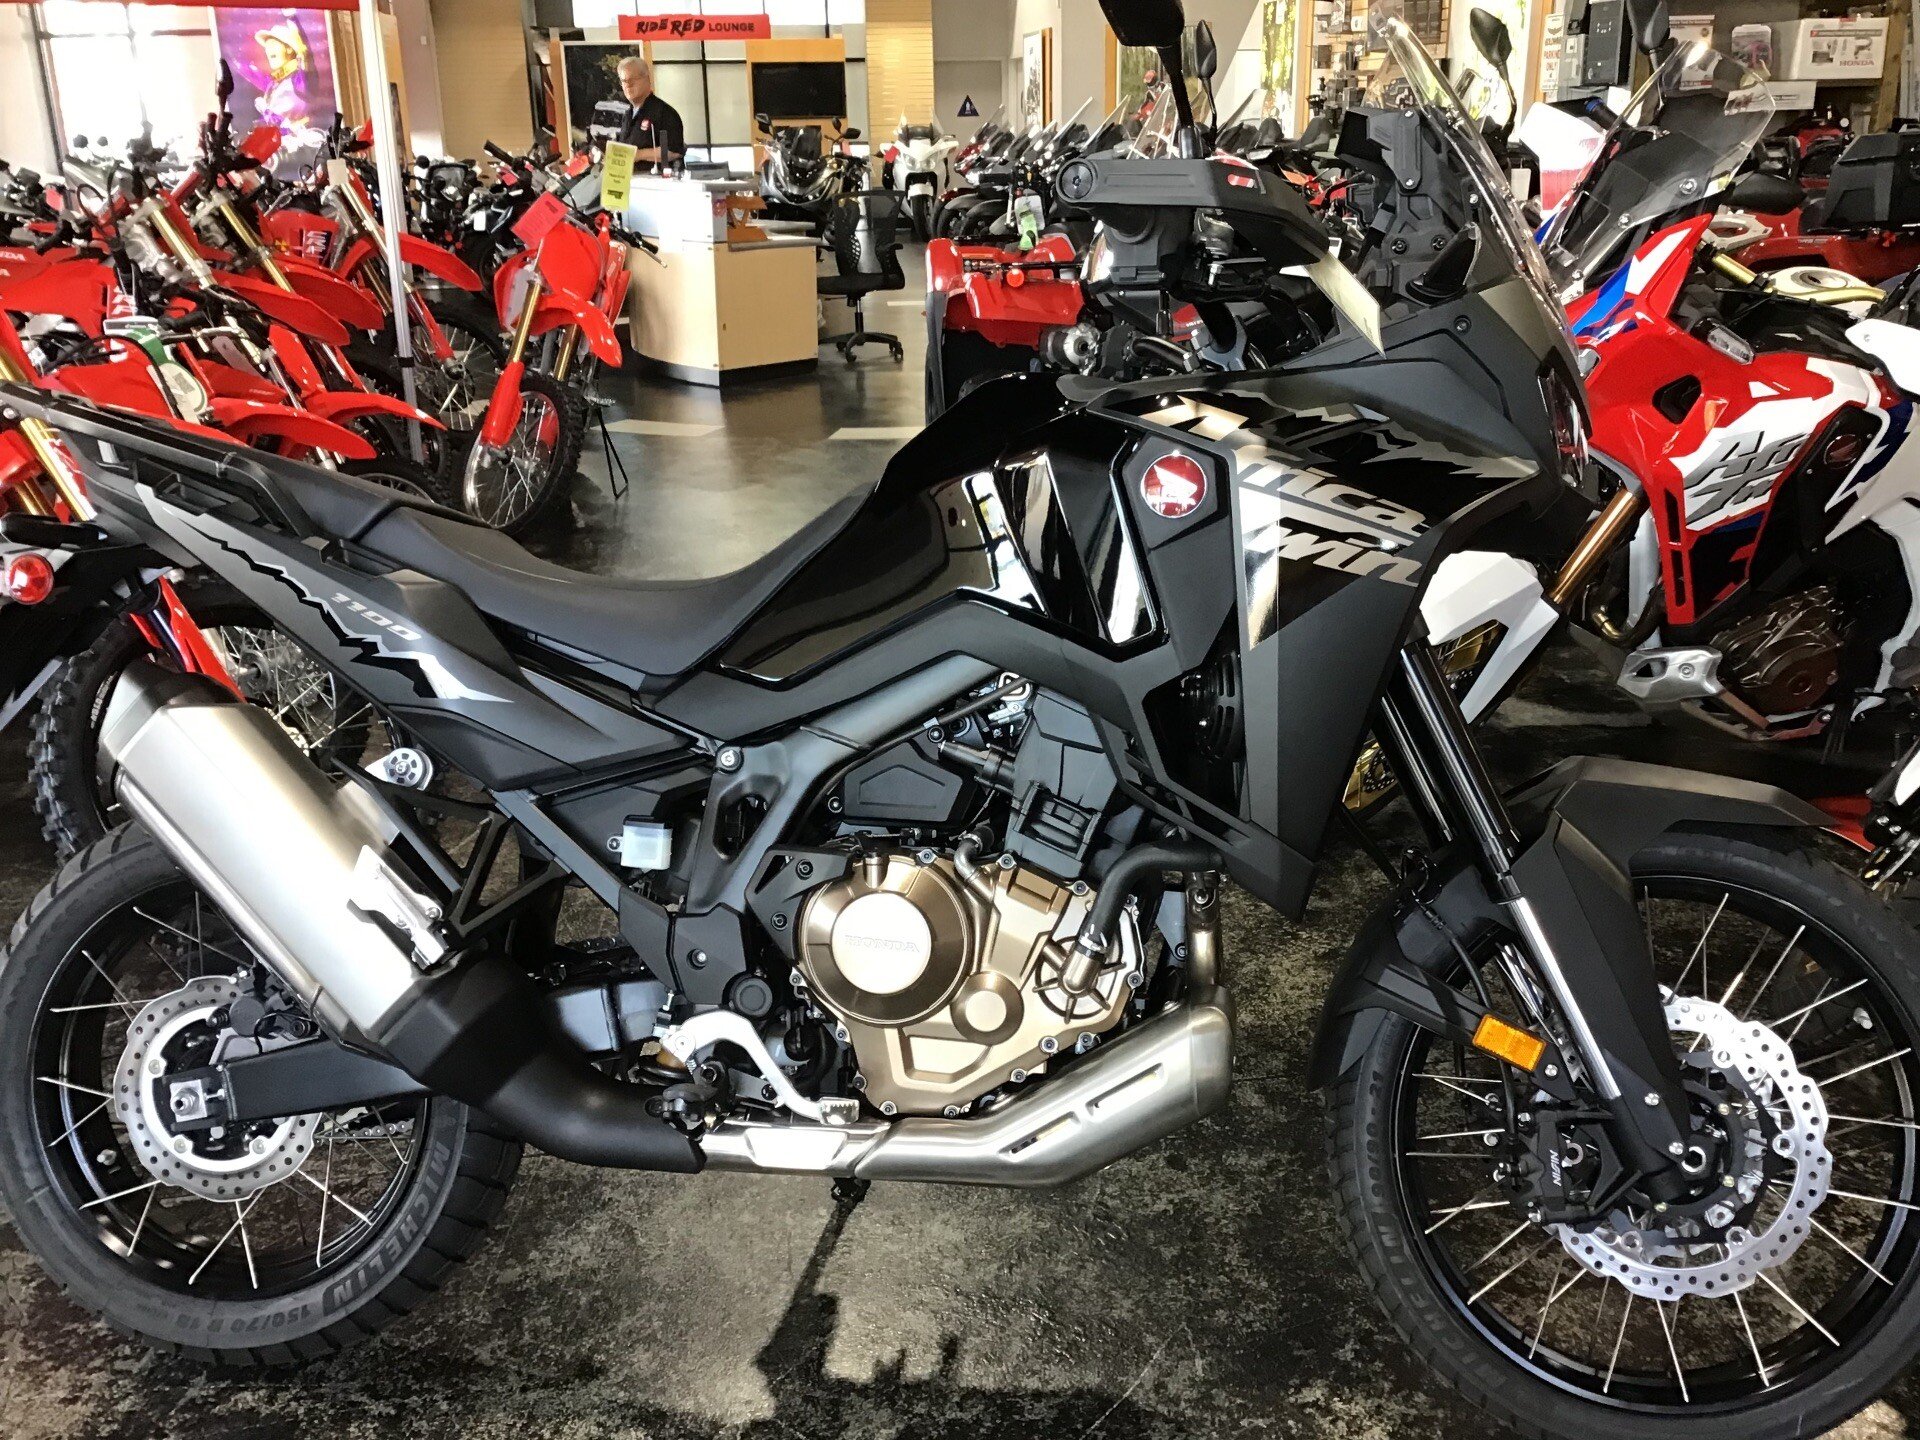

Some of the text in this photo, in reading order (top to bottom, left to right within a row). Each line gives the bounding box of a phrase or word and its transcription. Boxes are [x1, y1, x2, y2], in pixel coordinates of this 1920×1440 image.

[636, 18, 755, 37] RIDE RED LOUNGE
[331, 592, 422, 641] 1100
[333, 1141, 450, 1306] MICHELIN
